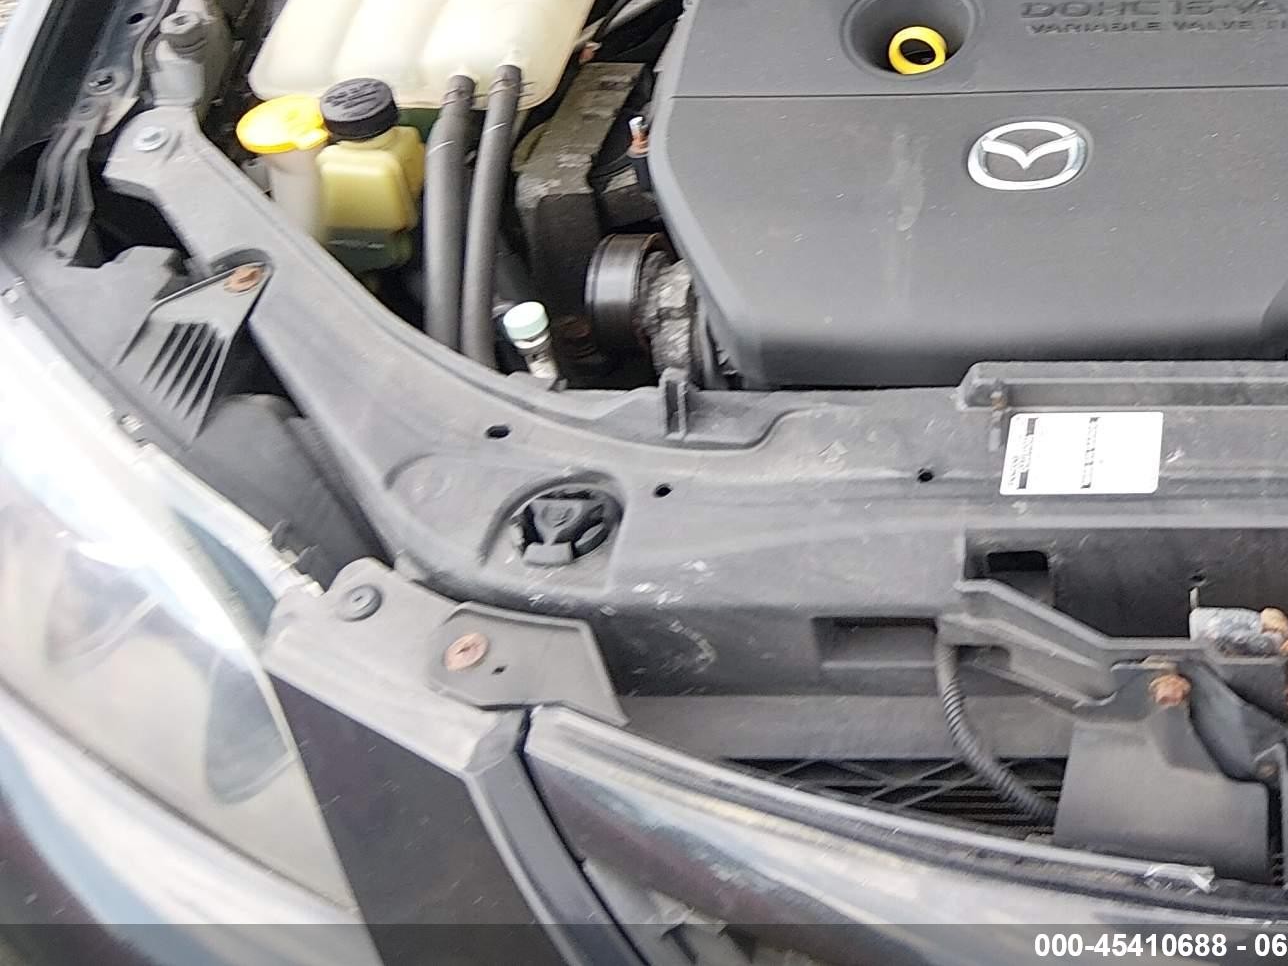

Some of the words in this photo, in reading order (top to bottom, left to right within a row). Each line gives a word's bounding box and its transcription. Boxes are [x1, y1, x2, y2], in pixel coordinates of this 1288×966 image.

[1020, 0, 1161, 19] DOHC
[1029, 20, 1162, 34] VARIABLE
[1172, 19, 1253, 31] VALVE
